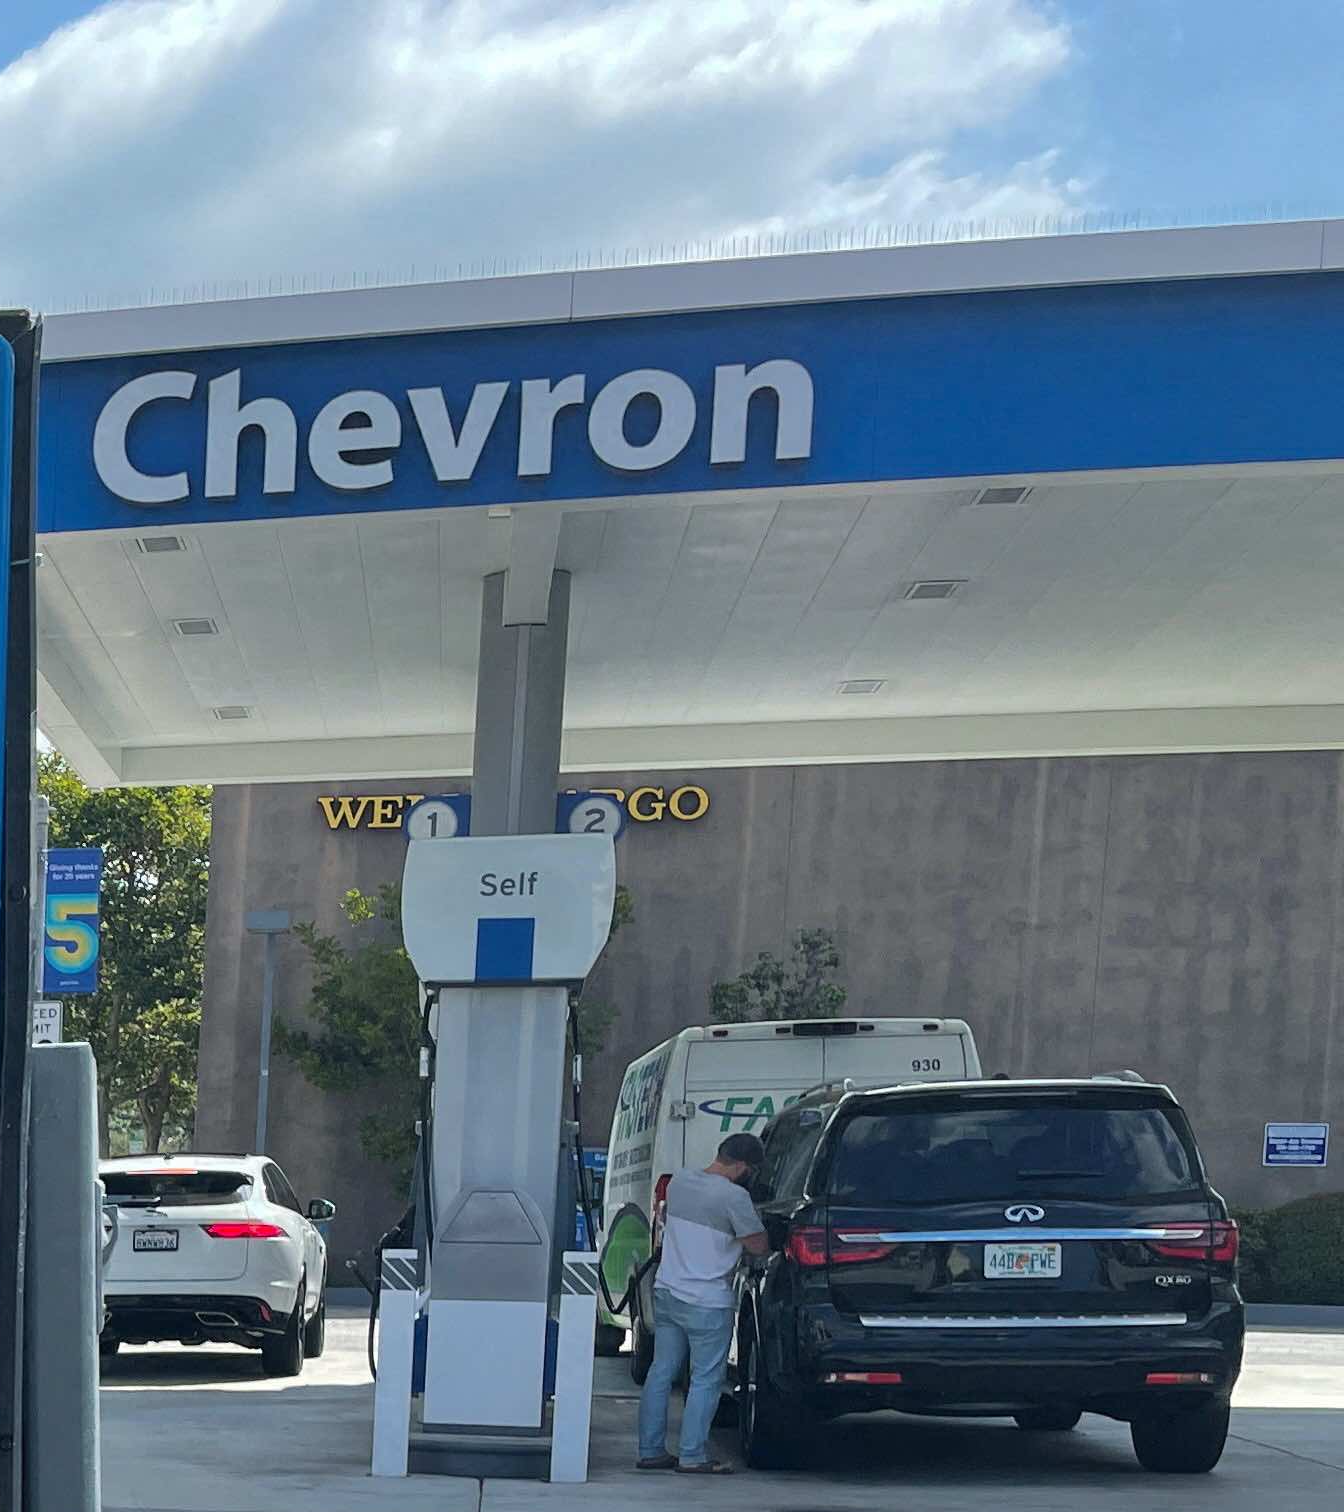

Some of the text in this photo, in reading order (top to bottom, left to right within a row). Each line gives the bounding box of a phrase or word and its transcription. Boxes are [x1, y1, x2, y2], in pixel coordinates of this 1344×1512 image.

[94, 357, 816, 505] Chevron
[425, 811, 439, 837] 1
[582, 807, 606, 833] 2
[479, 871, 539, 897] Self
[45, 892, 100, 975] 5
[911, 1058, 941, 1072] 930
